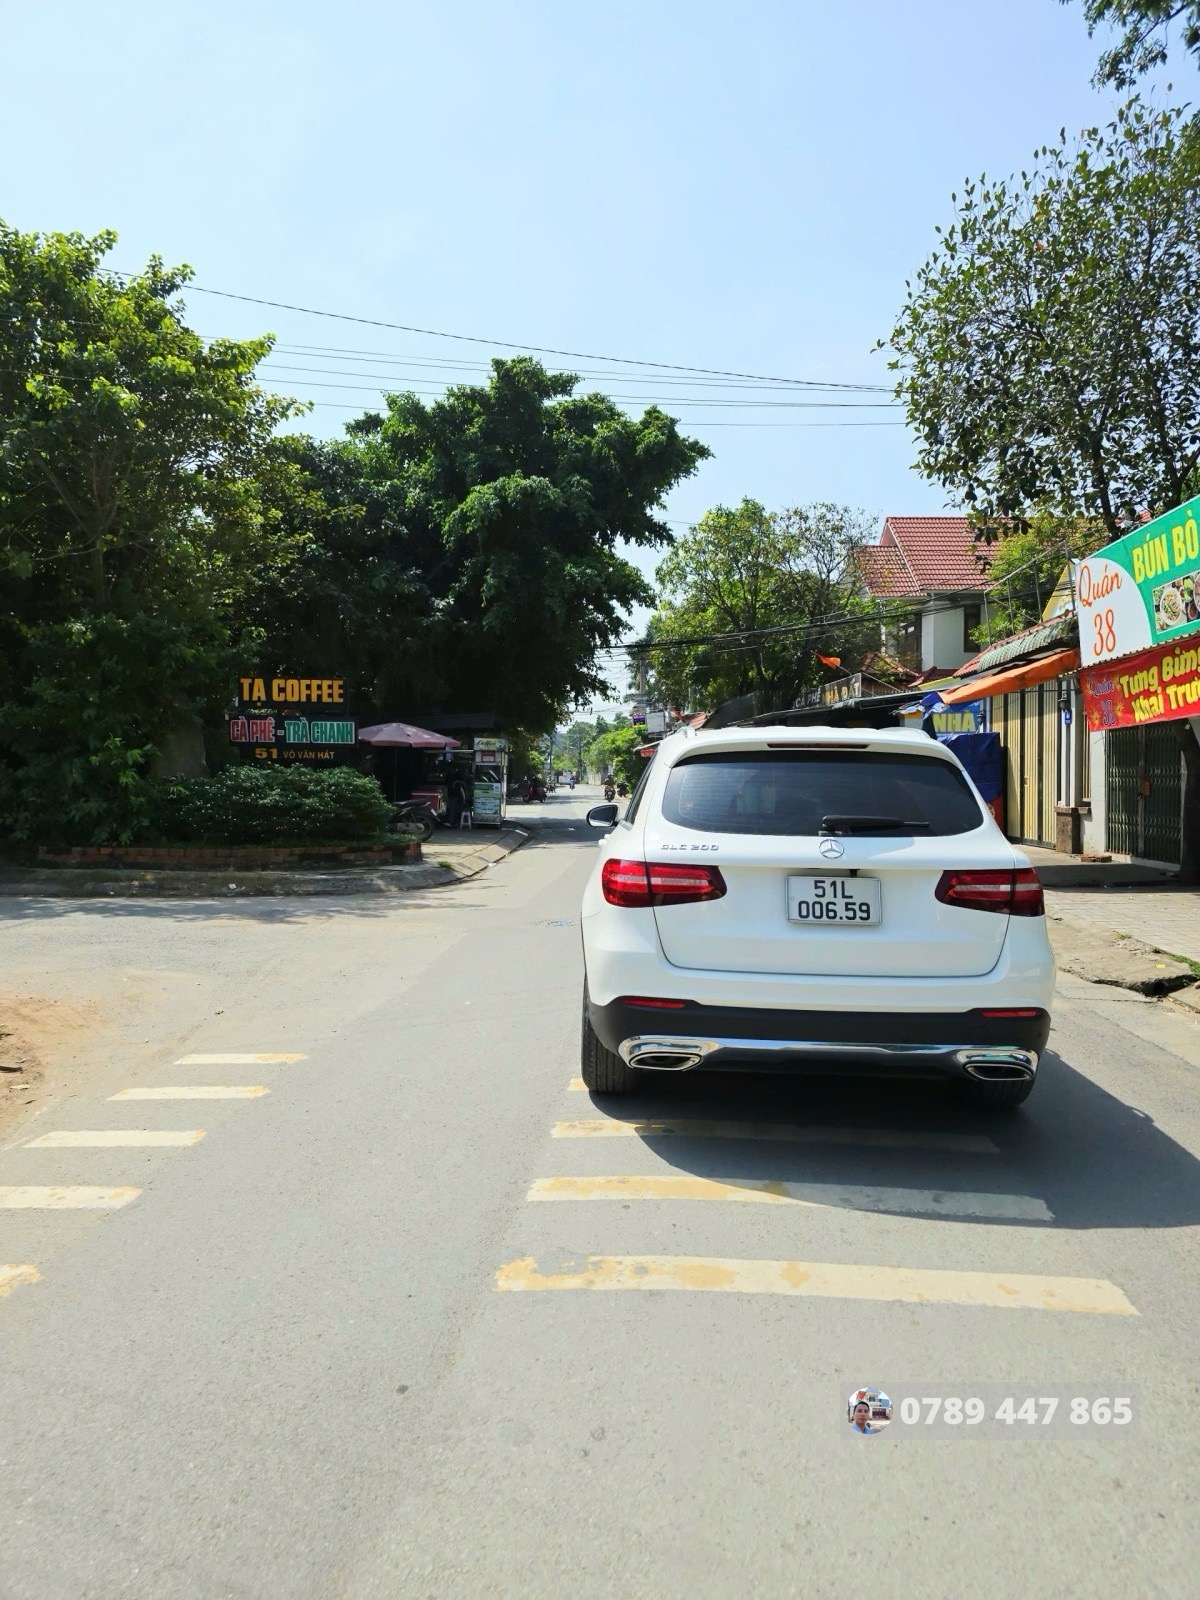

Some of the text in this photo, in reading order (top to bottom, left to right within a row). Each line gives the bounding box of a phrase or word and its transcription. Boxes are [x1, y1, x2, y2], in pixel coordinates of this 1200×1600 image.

[1133, 510, 1199, 584] BÚN BÒ
[1078, 564, 1123, 607] Quán
[1094, 609, 1117, 656] 38
[1162, 647, 1200, 682] Bừn
[240, 678, 344, 706] TẠ COFFEE
[1131, 686, 1165, 723] Khai
[230, 716, 249, 742] CÀ
[250, 716, 275, 743] PHÊ
[285, 717, 311, 743] TRÀ
[311, 721, 356, 744] CHANH
[255, 748, 278, 759] 51
[660, 844, 719, 852] GLC 200
[814, 880, 853, 899] 51L
[798, 901, 871, 921] 006.59
